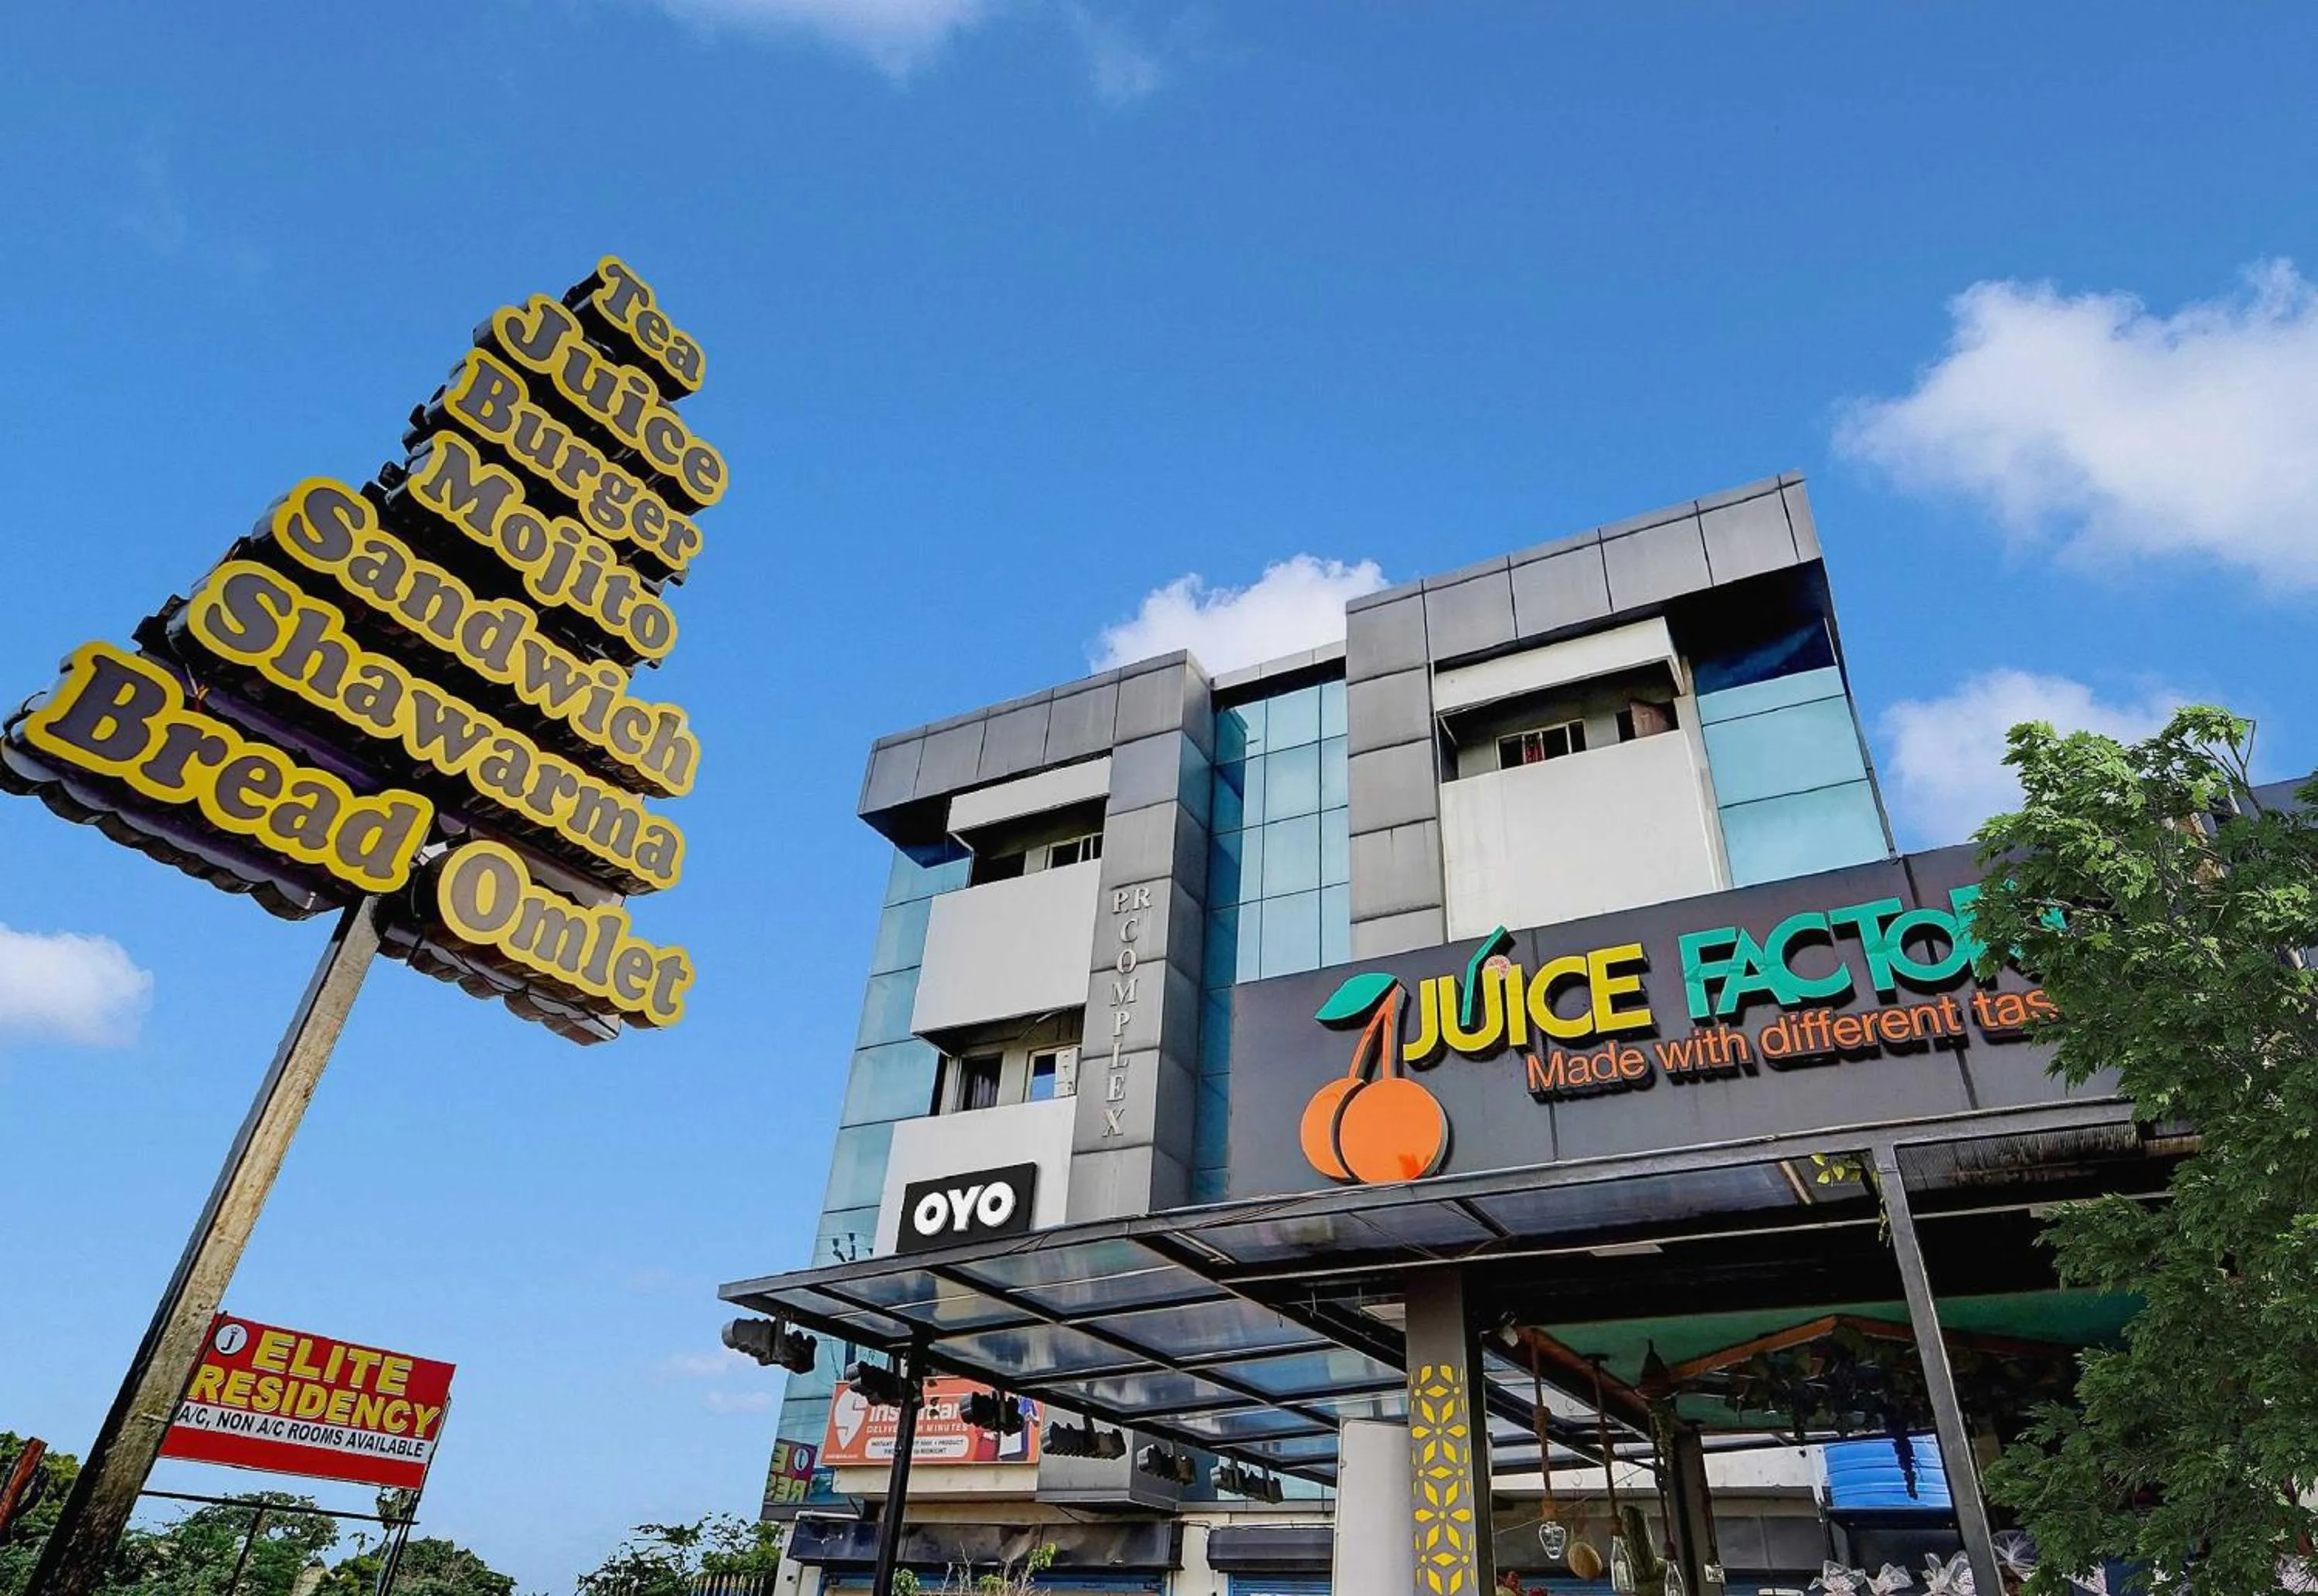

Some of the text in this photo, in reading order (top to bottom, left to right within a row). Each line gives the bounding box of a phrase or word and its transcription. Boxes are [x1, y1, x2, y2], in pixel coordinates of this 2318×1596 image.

[501, 295, 724, 498] Juice
[603, 260, 704, 384] Tea
[454, 357, 701, 564] Burger
[417, 439, 672, 653] Mojito
[284, 482, 695, 788] Sandwich
[202, 569, 678, 881] Shawarma
[45, 653, 695, 1019] Bread Omlet
[1102, 917, 1139, 1138] COMPLEX
[1402, 942, 1653, 1062] JUICE
[1527, 1040, 1647, 1092] Made
[1655, 1020, 1749, 1073] with
[1760, 993, 1963, 1058] different
[913, 1181, 1016, 1236] OYO
[177, 1405, 424, 1458] A/C, NON A/C ROOMS AVAILABLE
[187, 1363, 441, 1437] RESIDENCY
[250, 1329, 414, 1397] ELITE
